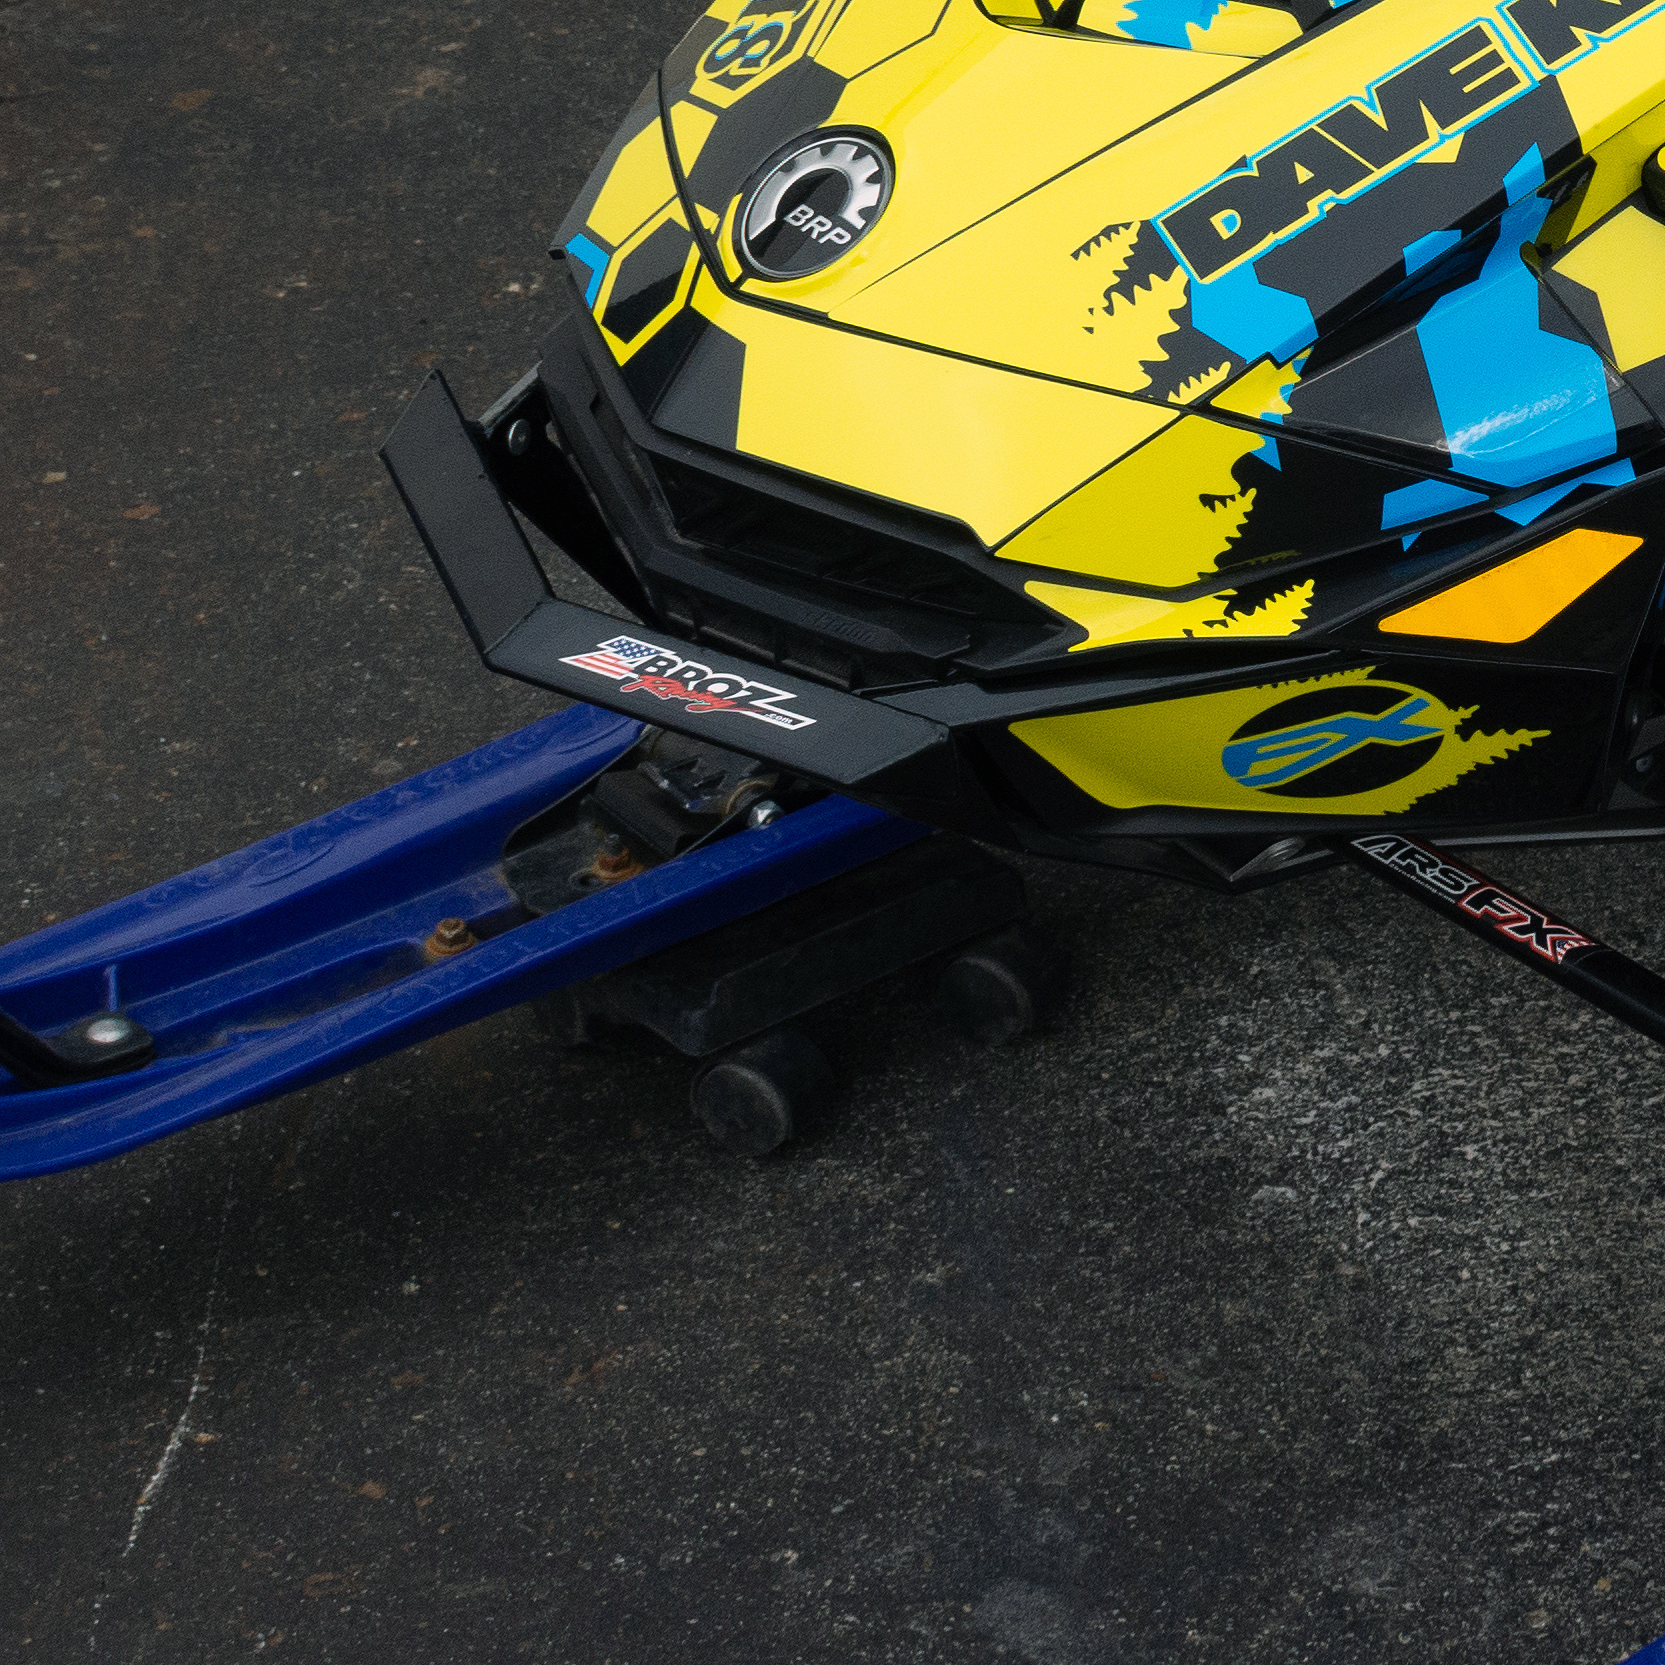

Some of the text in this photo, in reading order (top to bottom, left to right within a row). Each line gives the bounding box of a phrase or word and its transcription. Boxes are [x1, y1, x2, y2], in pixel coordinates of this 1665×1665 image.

[1162, 25, 1528, 279] DAVE
[784, 204, 851, 246] BRP
[1350, 834, 1592, 965] ARS FX
